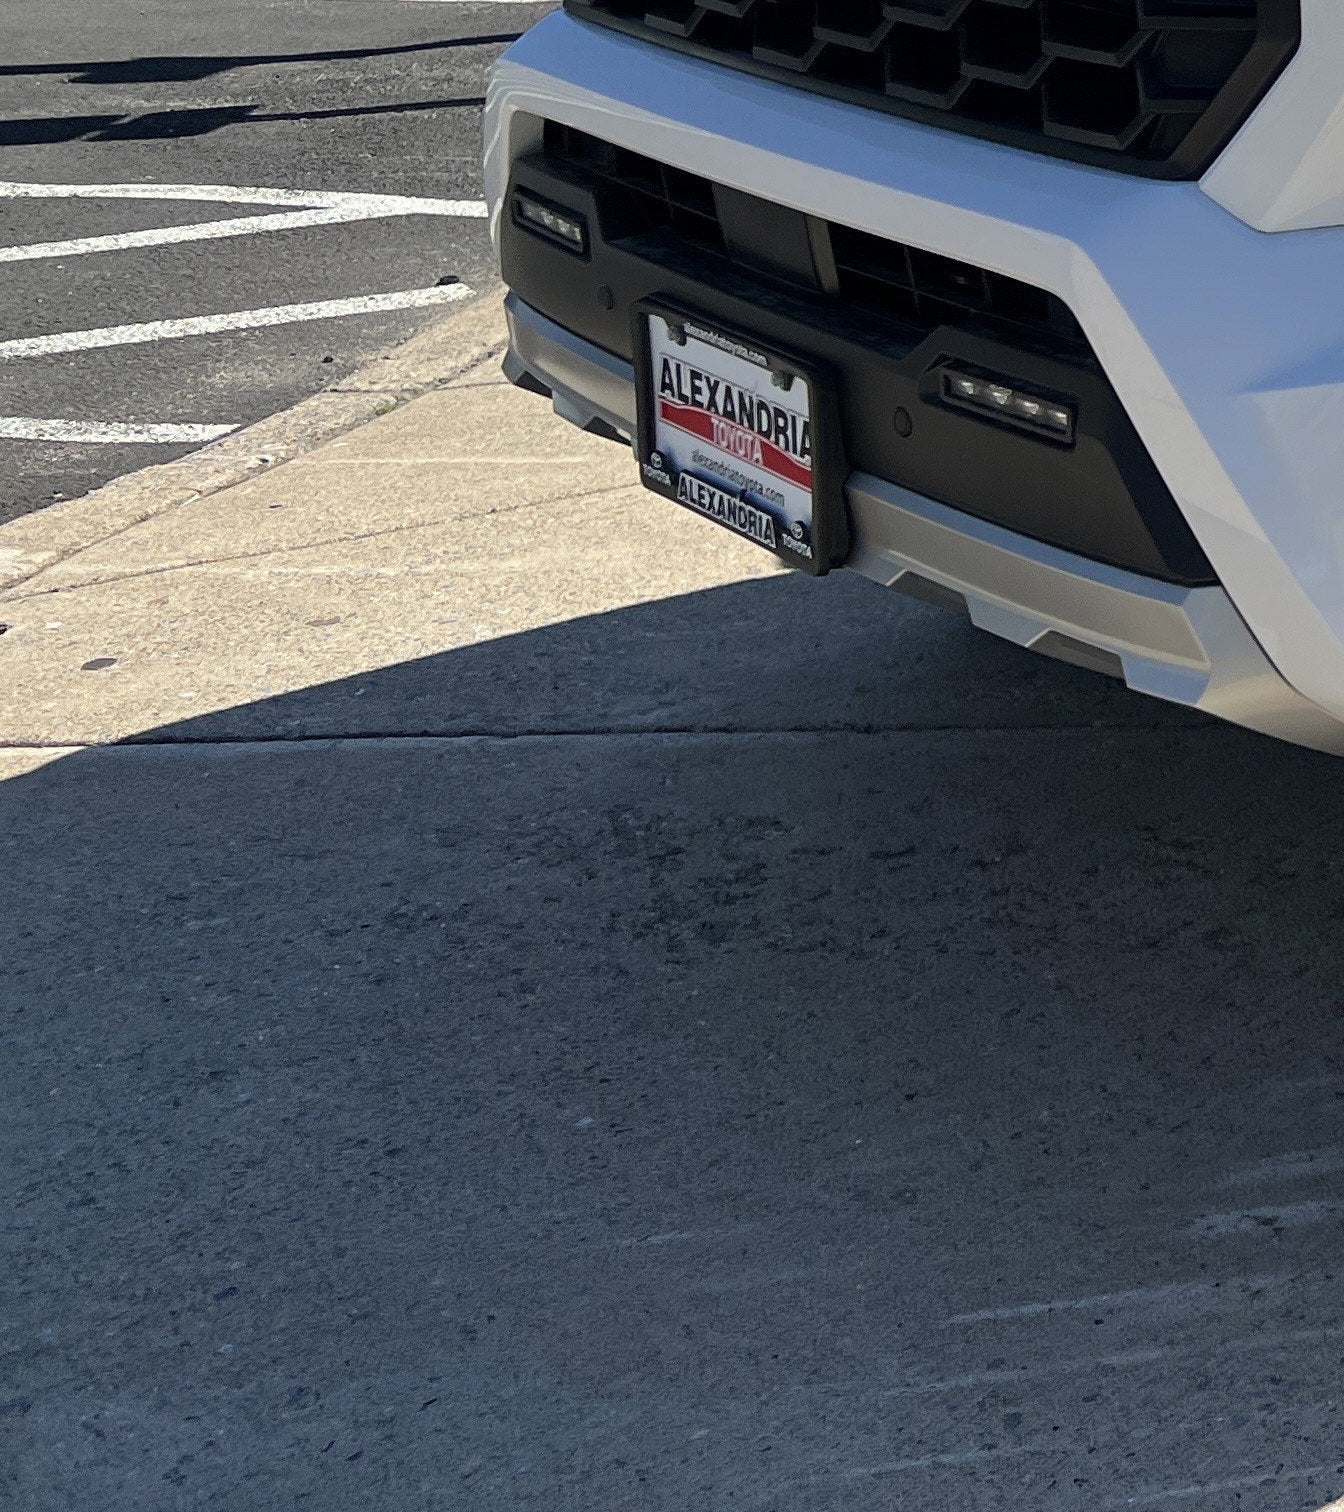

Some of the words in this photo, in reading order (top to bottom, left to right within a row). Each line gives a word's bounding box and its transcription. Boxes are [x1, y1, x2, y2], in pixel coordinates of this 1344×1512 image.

[660, 357, 811, 459] ALEXANDRIA
[711, 417, 765, 466] TOYOTA
[677, 472, 776, 548] ALEXANDRIA
